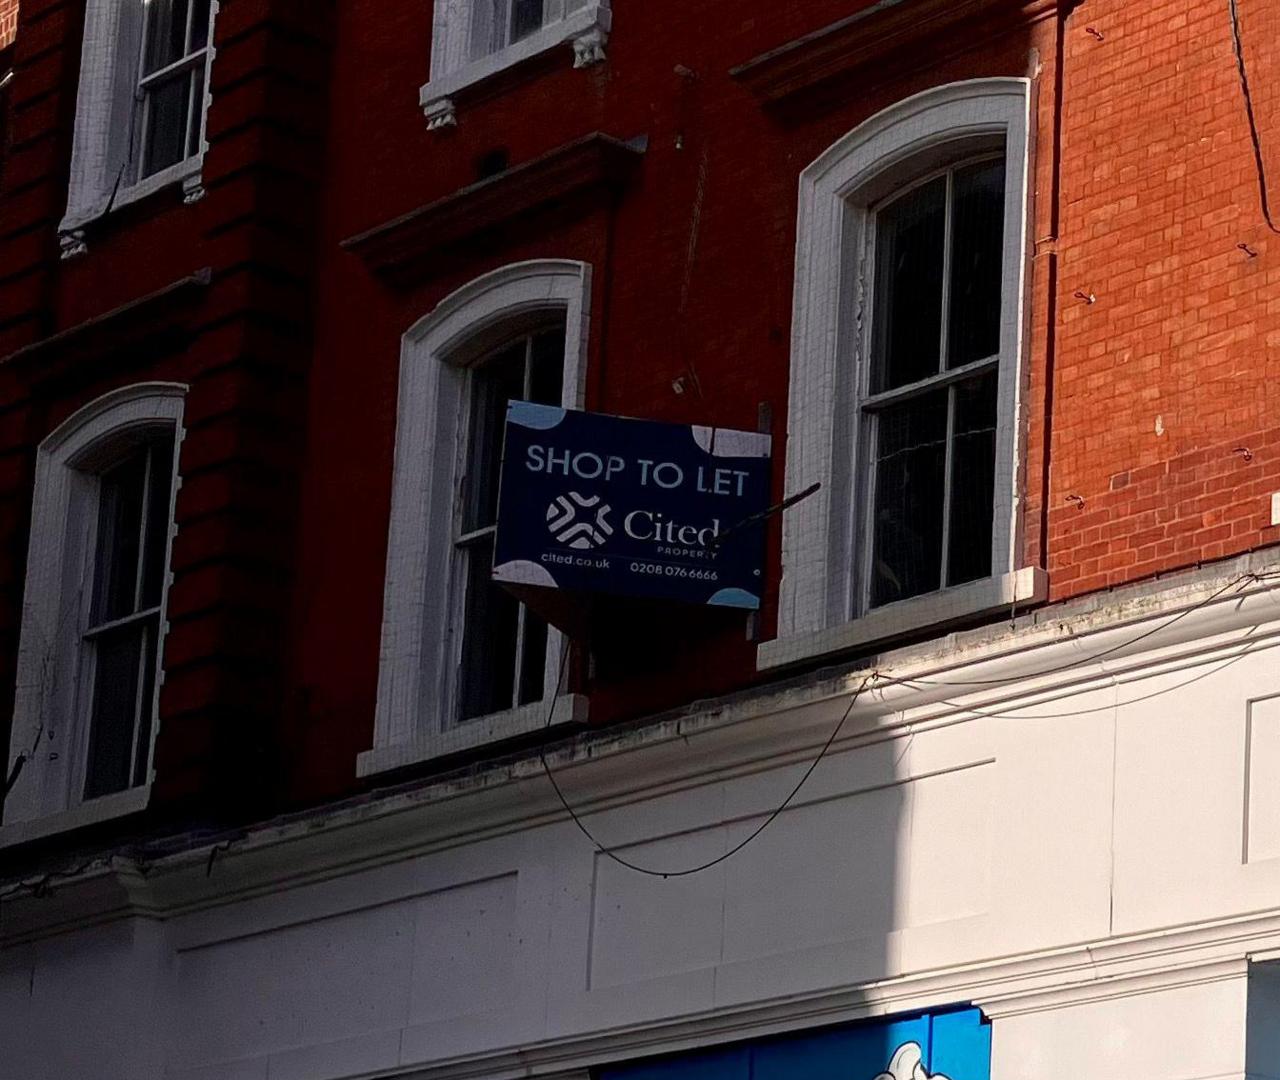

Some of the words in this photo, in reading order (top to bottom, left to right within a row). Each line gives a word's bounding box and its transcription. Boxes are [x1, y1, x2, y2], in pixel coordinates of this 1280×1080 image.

[525, 445, 625, 481] SHOP
[637, 459, 684, 489] TO
[697, 466, 750, 497] LET
[624, 510, 720, 547] Cited
[541, 552, 610, 569] cited.co.uk
[630, 561, 663, 576] 0208
[664, 565, 688, 579] 076
[688, 568, 718, 581] 6666
[656, 546, 718, 560] PROPERY
